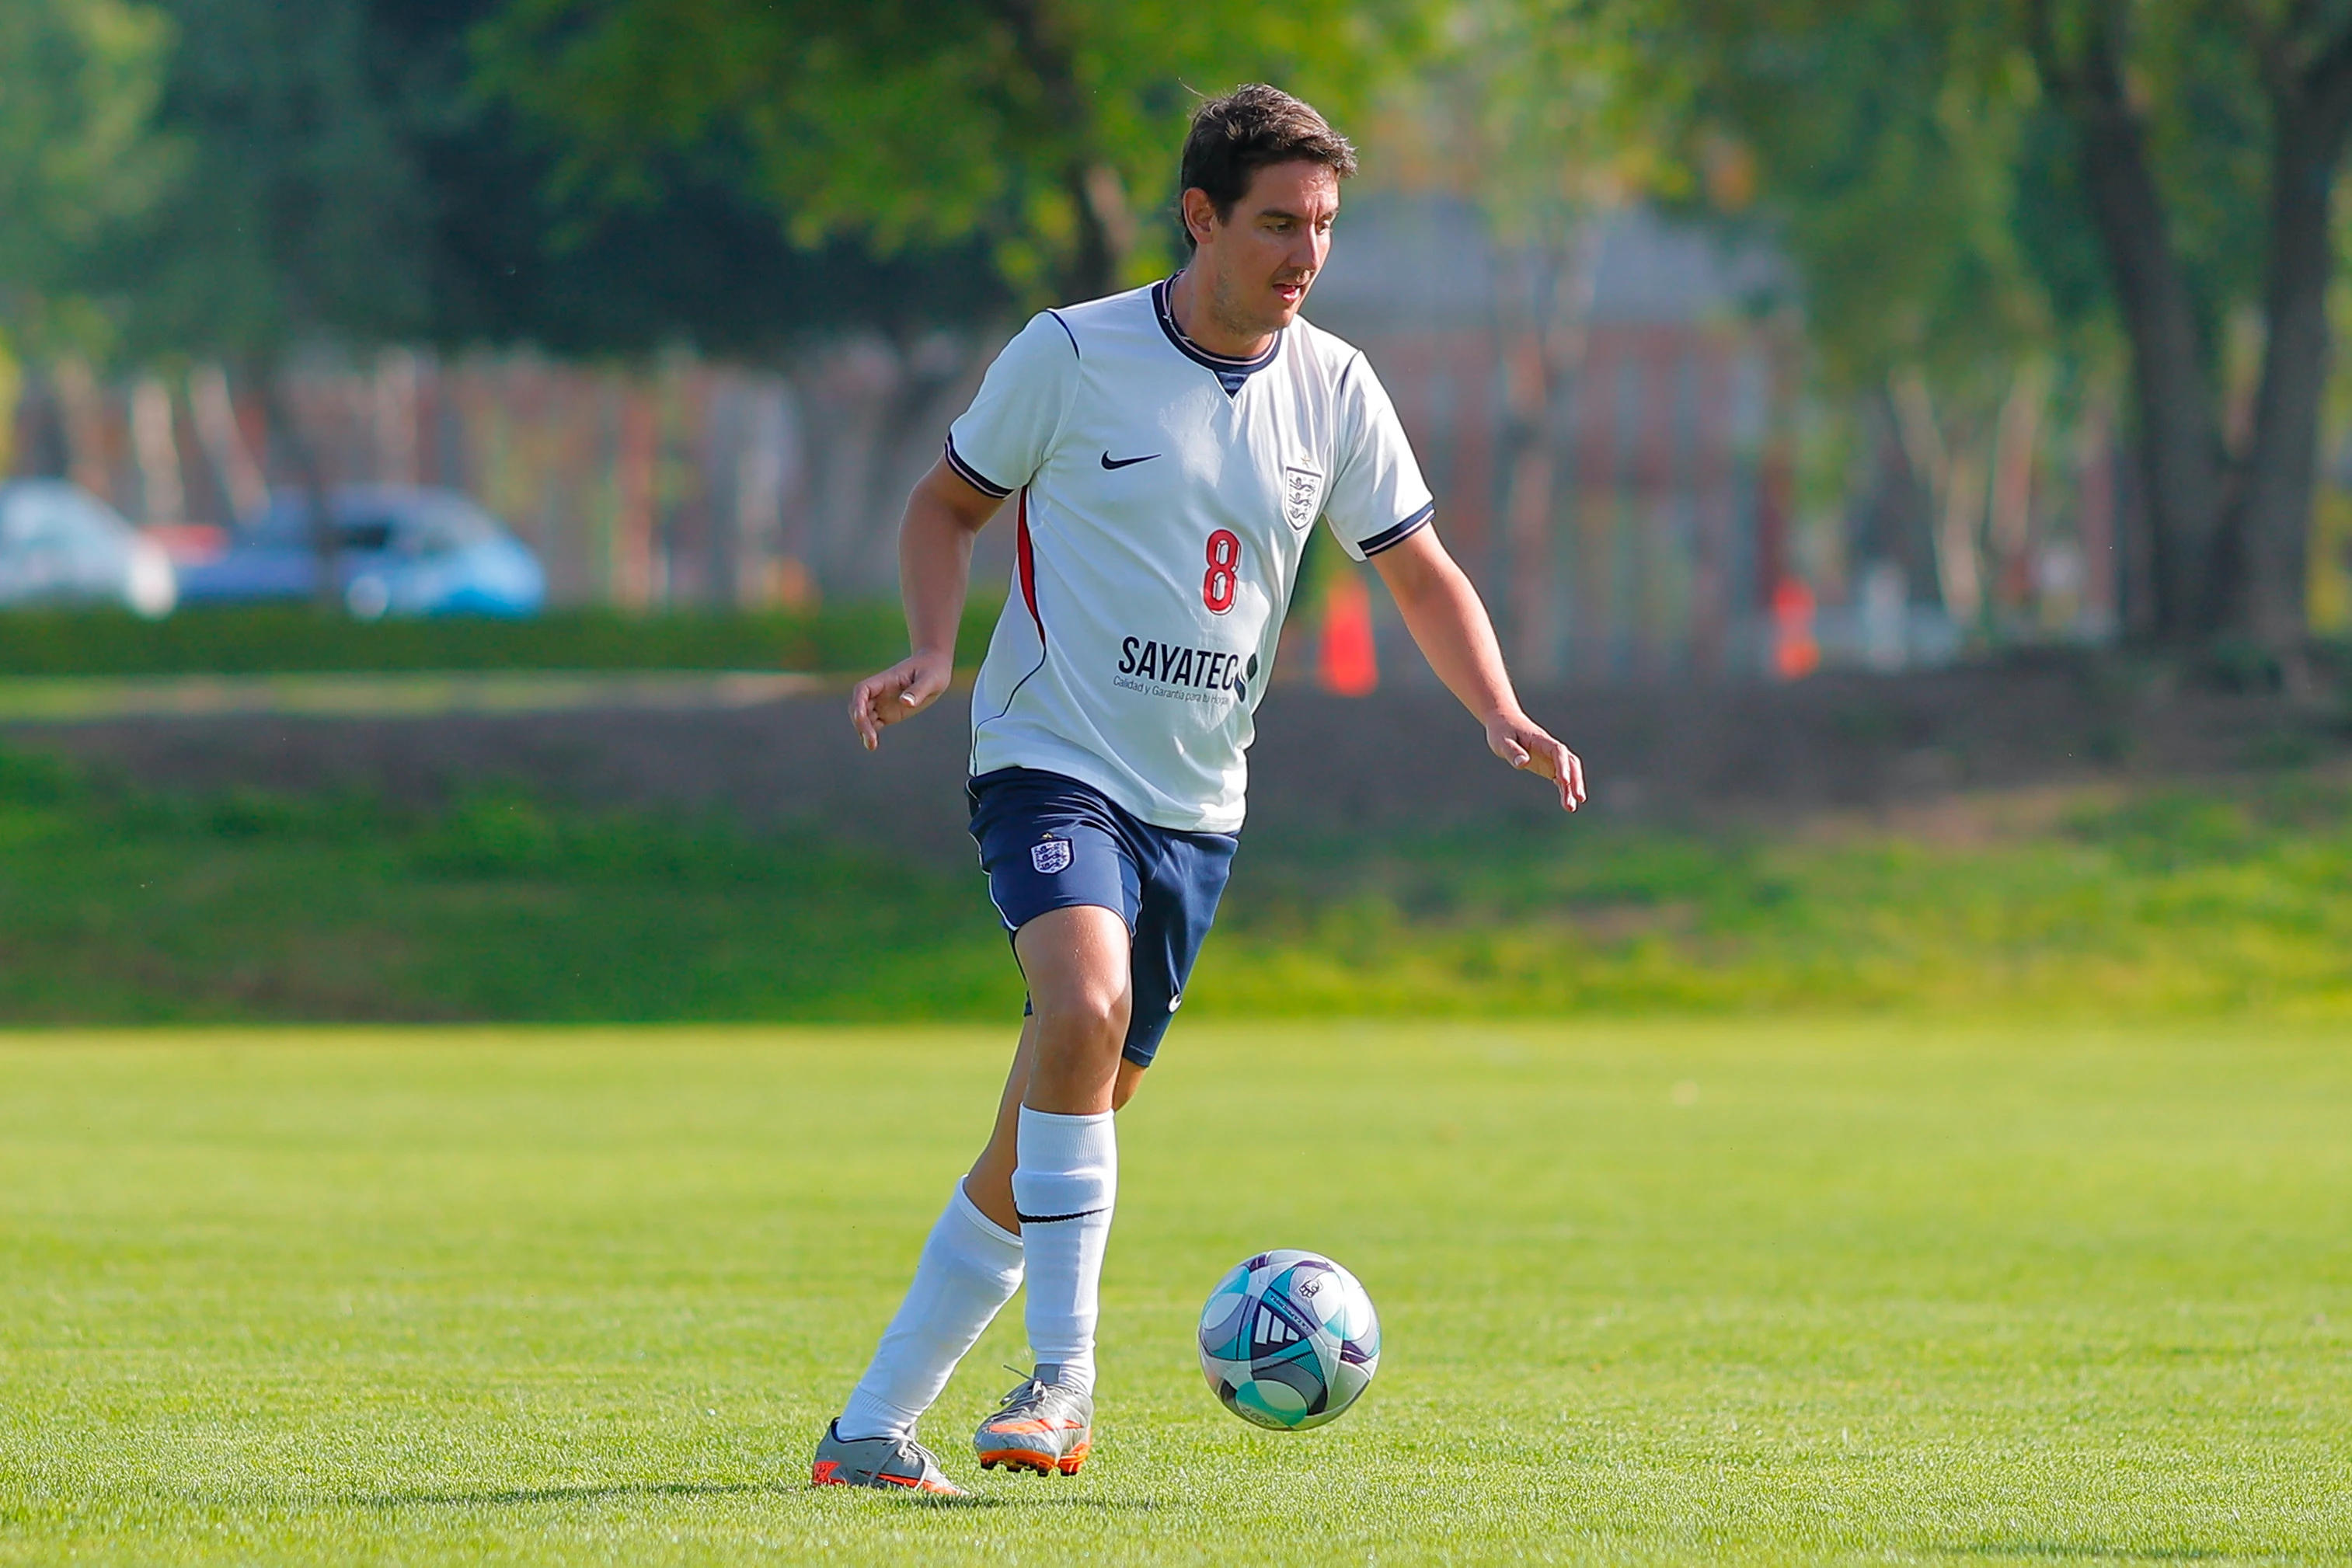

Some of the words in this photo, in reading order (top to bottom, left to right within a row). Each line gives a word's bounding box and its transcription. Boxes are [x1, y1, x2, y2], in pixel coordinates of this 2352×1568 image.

[1203, 528, 1242, 615] 8
[1113, 675, 1144, 692] Calidad
[1145, 685, 1151, 695] y
[1118, 636, 1239, 691] SAYATEC
